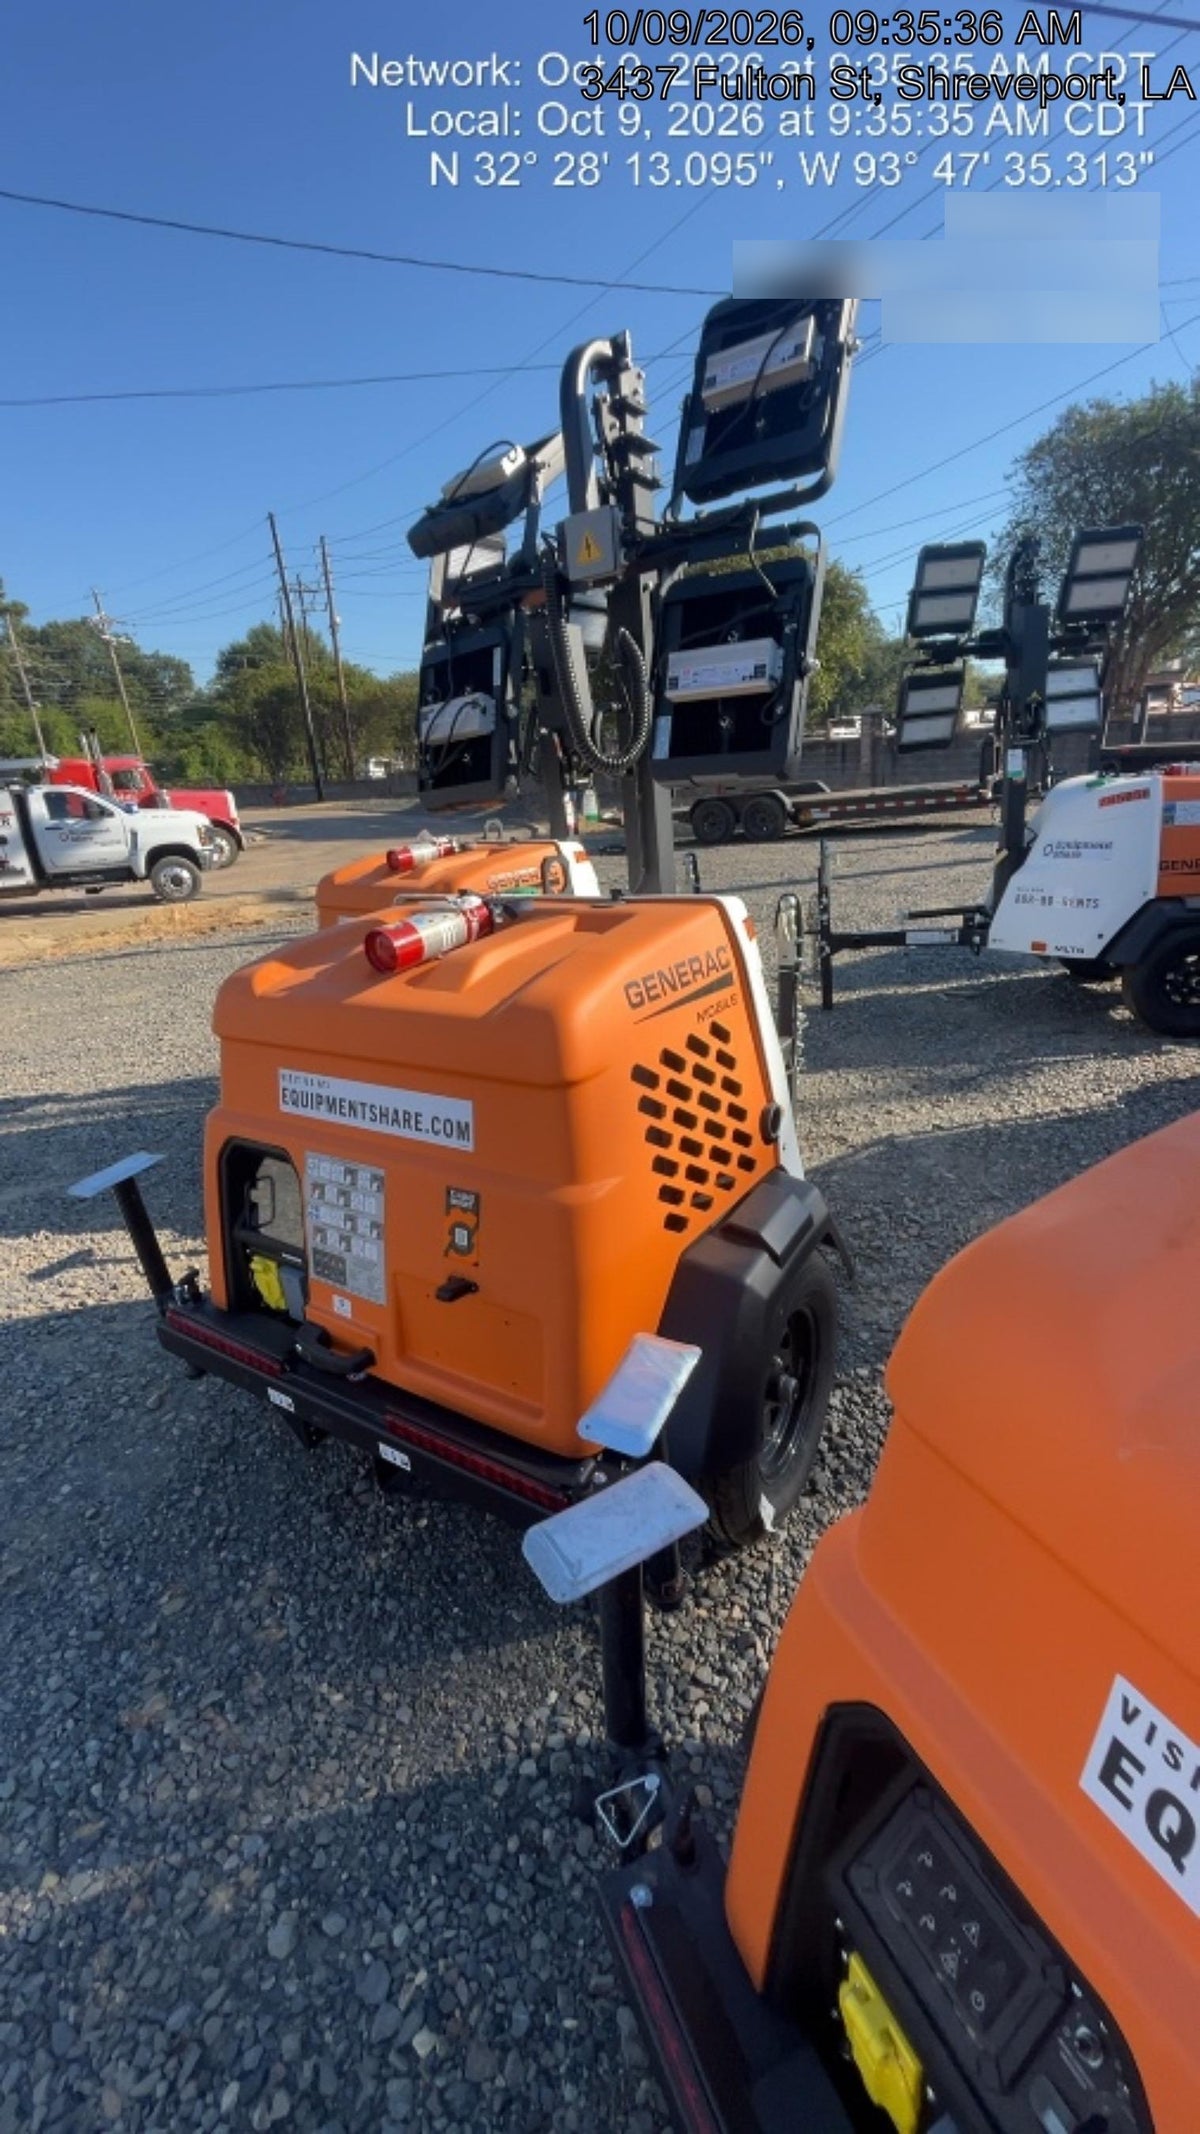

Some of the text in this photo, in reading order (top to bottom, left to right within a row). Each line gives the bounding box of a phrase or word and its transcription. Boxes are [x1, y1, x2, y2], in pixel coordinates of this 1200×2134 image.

[624, 944, 732, 1012] GENERAC
[281, 1087, 471, 1143] EQUIPMENTSHARE.COM
[1098, 1735, 1197, 1876] EQ
